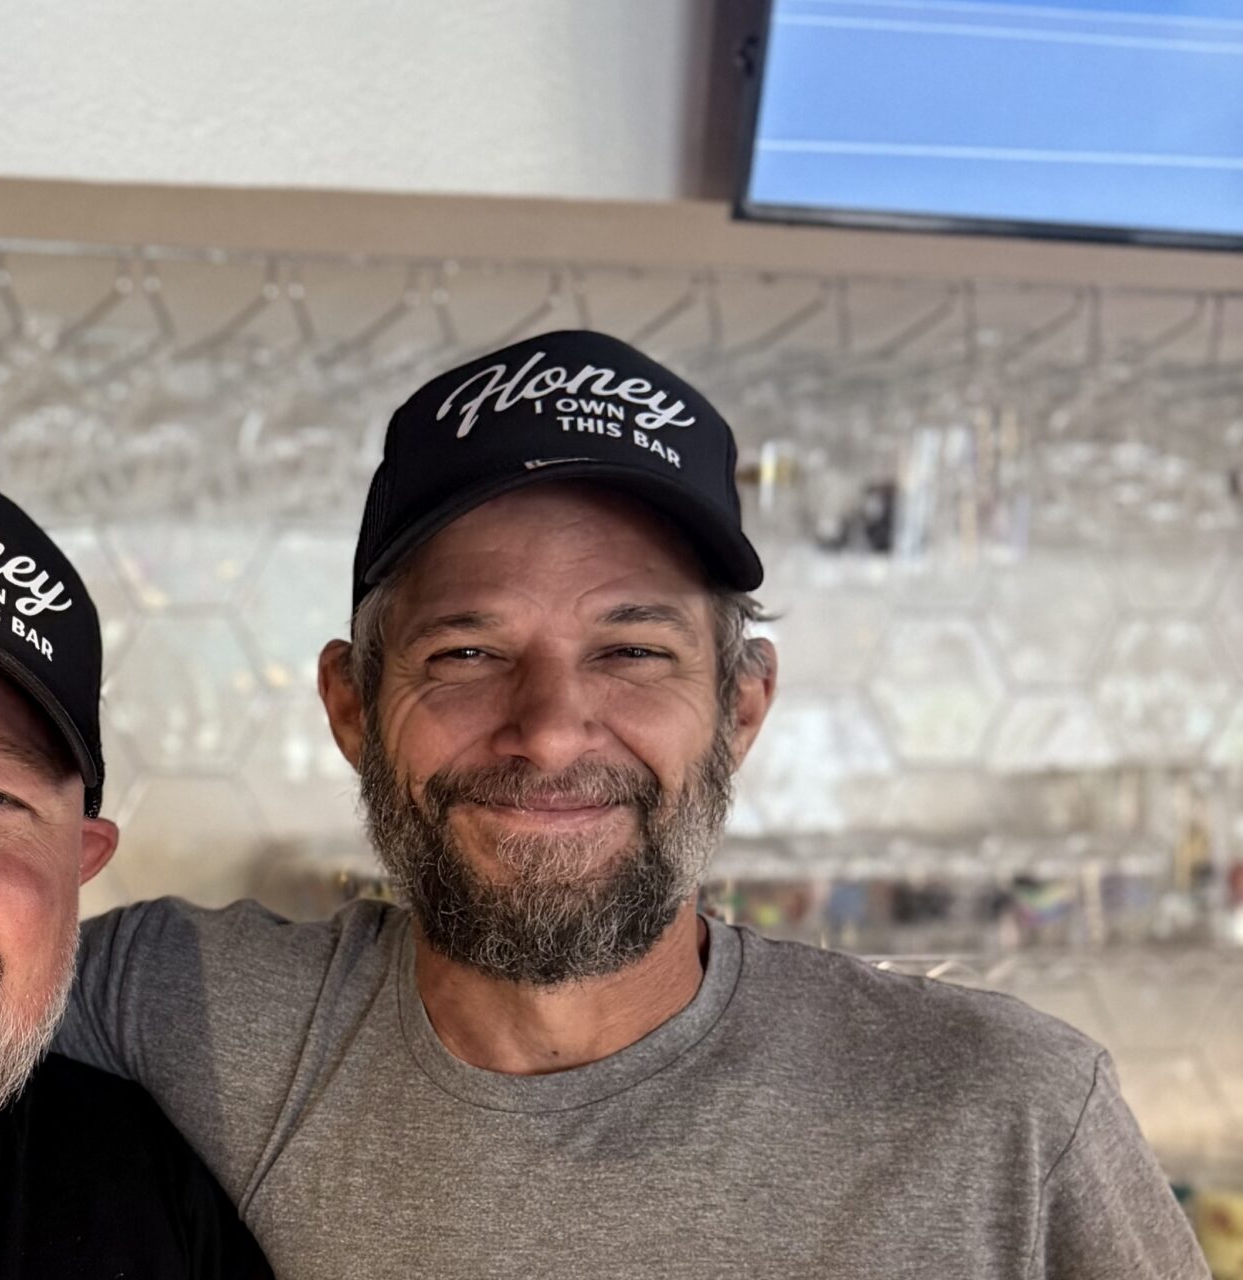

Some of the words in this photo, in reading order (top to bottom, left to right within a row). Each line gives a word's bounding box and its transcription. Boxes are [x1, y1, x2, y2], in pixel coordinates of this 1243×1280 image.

[436, 351, 696, 438] Honey
[534, 401, 543, 414] I
[556, 399, 625, 421] OWN
[556, 416, 622, 438] THIS
[633, 430, 681, 469] BAR
[11, 616, 54, 662] BAR
